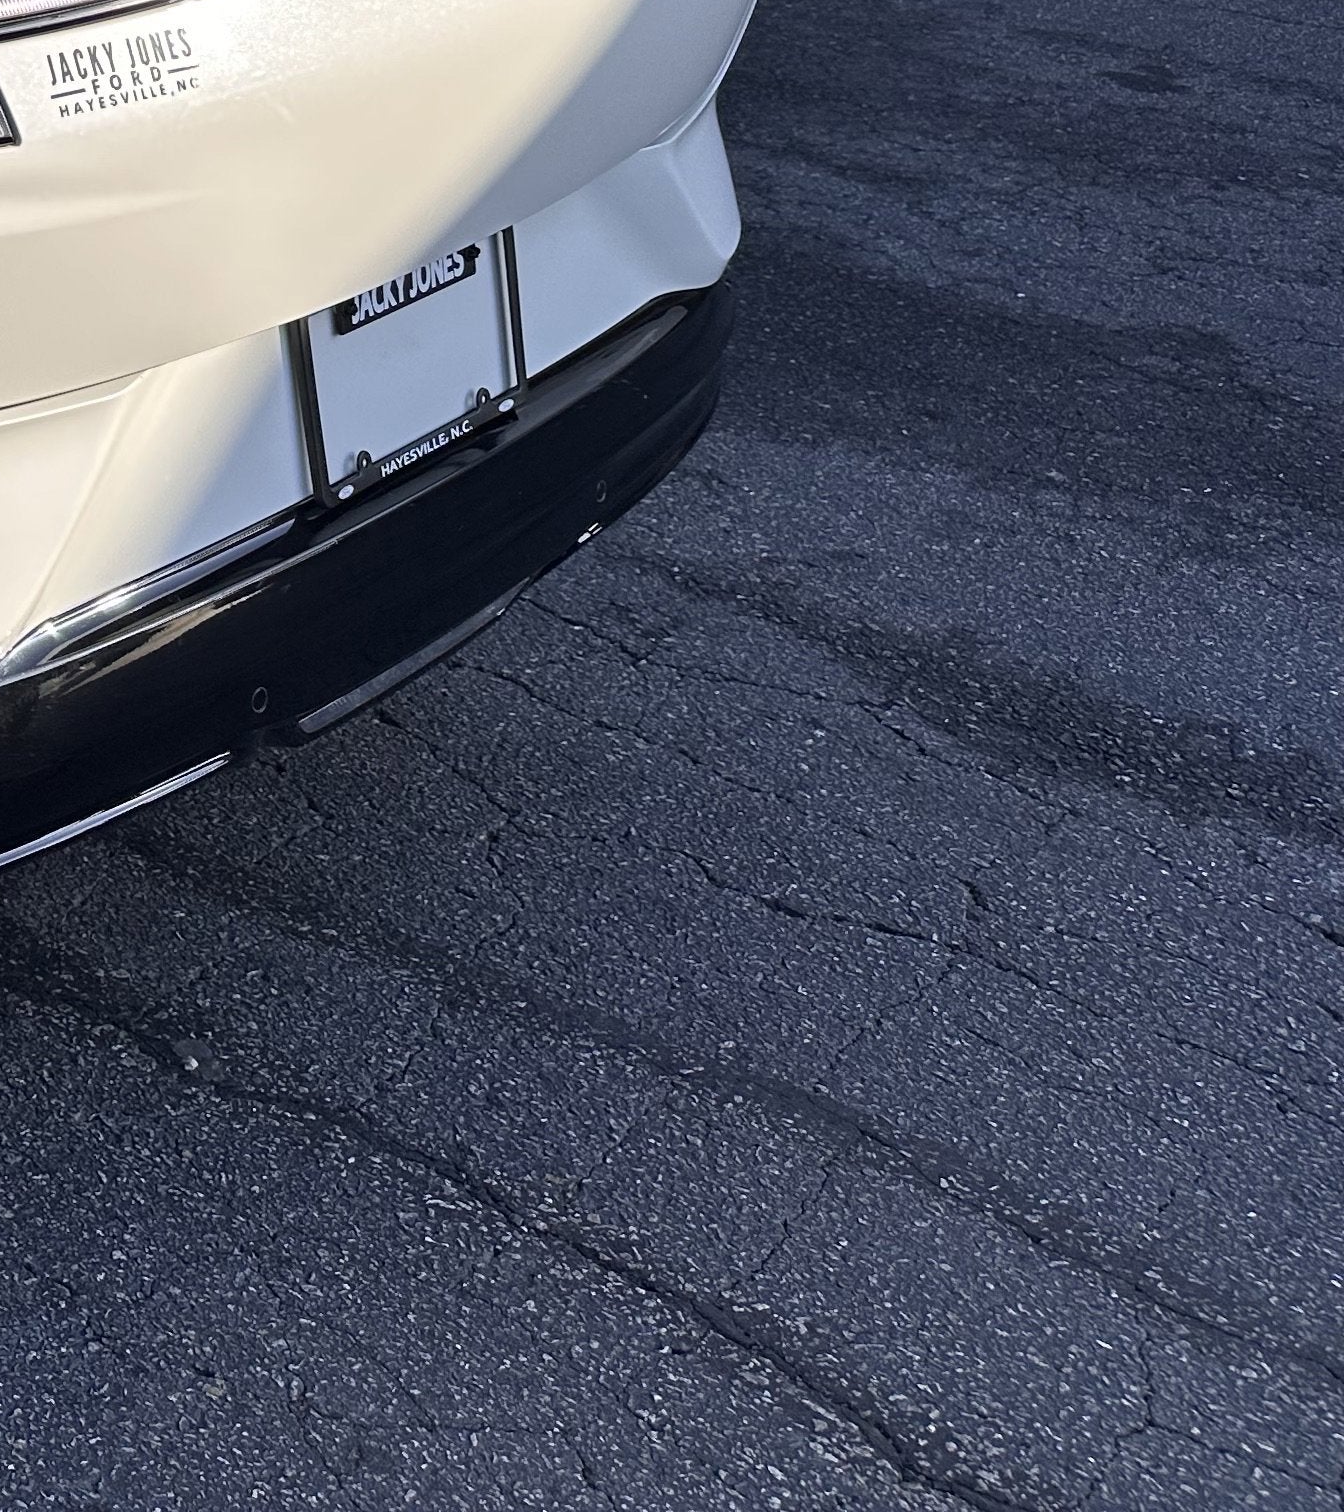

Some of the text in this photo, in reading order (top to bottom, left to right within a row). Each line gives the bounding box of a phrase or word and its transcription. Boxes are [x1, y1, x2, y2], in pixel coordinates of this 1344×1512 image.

[46, 28, 192, 86] JACKY JONES
[91, 66, 162, 95] FORD
[351, 251, 465, 325] JACKY JONES
[380, 419, 475, 478] HAYESVILLE, N.C.
